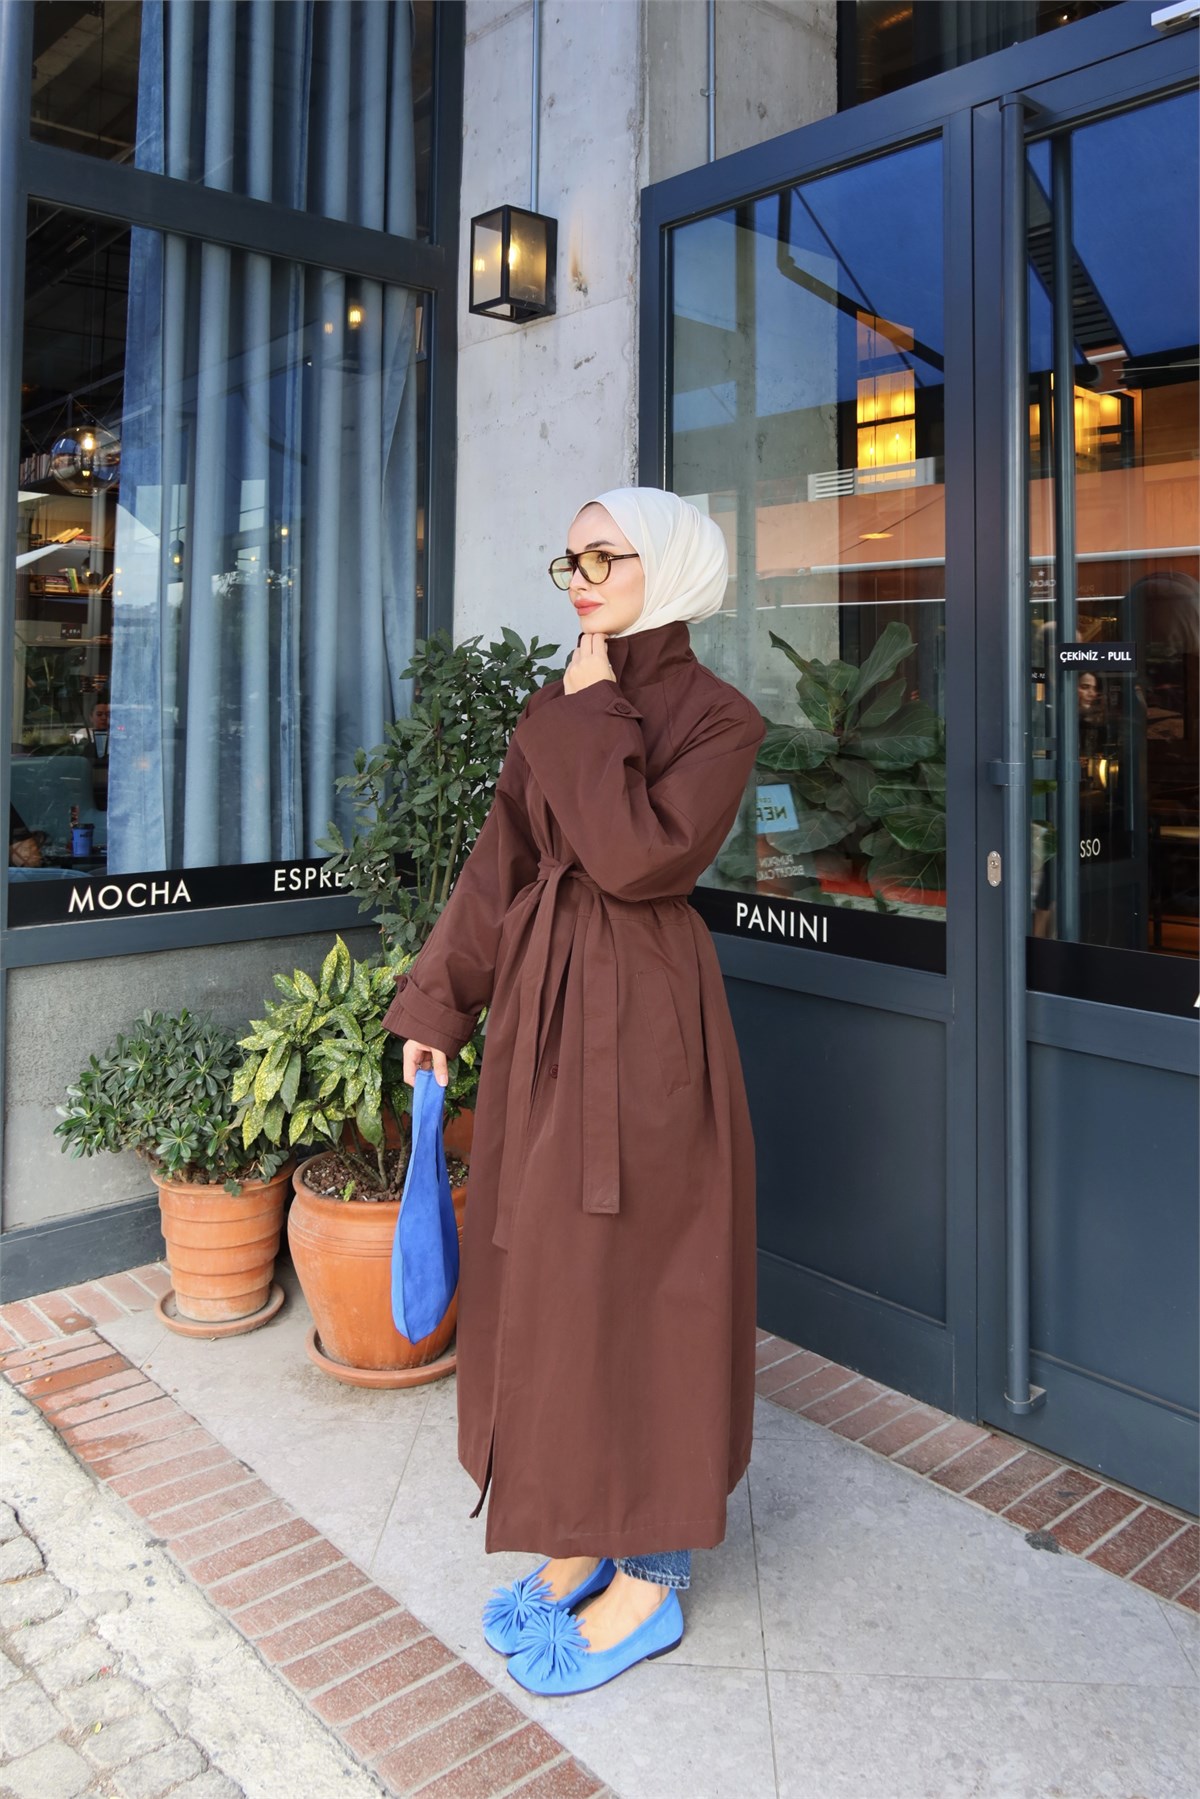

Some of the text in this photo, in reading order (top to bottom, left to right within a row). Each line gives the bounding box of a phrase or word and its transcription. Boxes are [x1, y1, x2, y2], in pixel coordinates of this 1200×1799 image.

[1060, 650, 1098, 662] ÇEKİNİZ
[1107, 651, 1131, 661] PULL
[68, 879, 191, 913] MOCHA
[736, 902, 827, 943] PANINI
